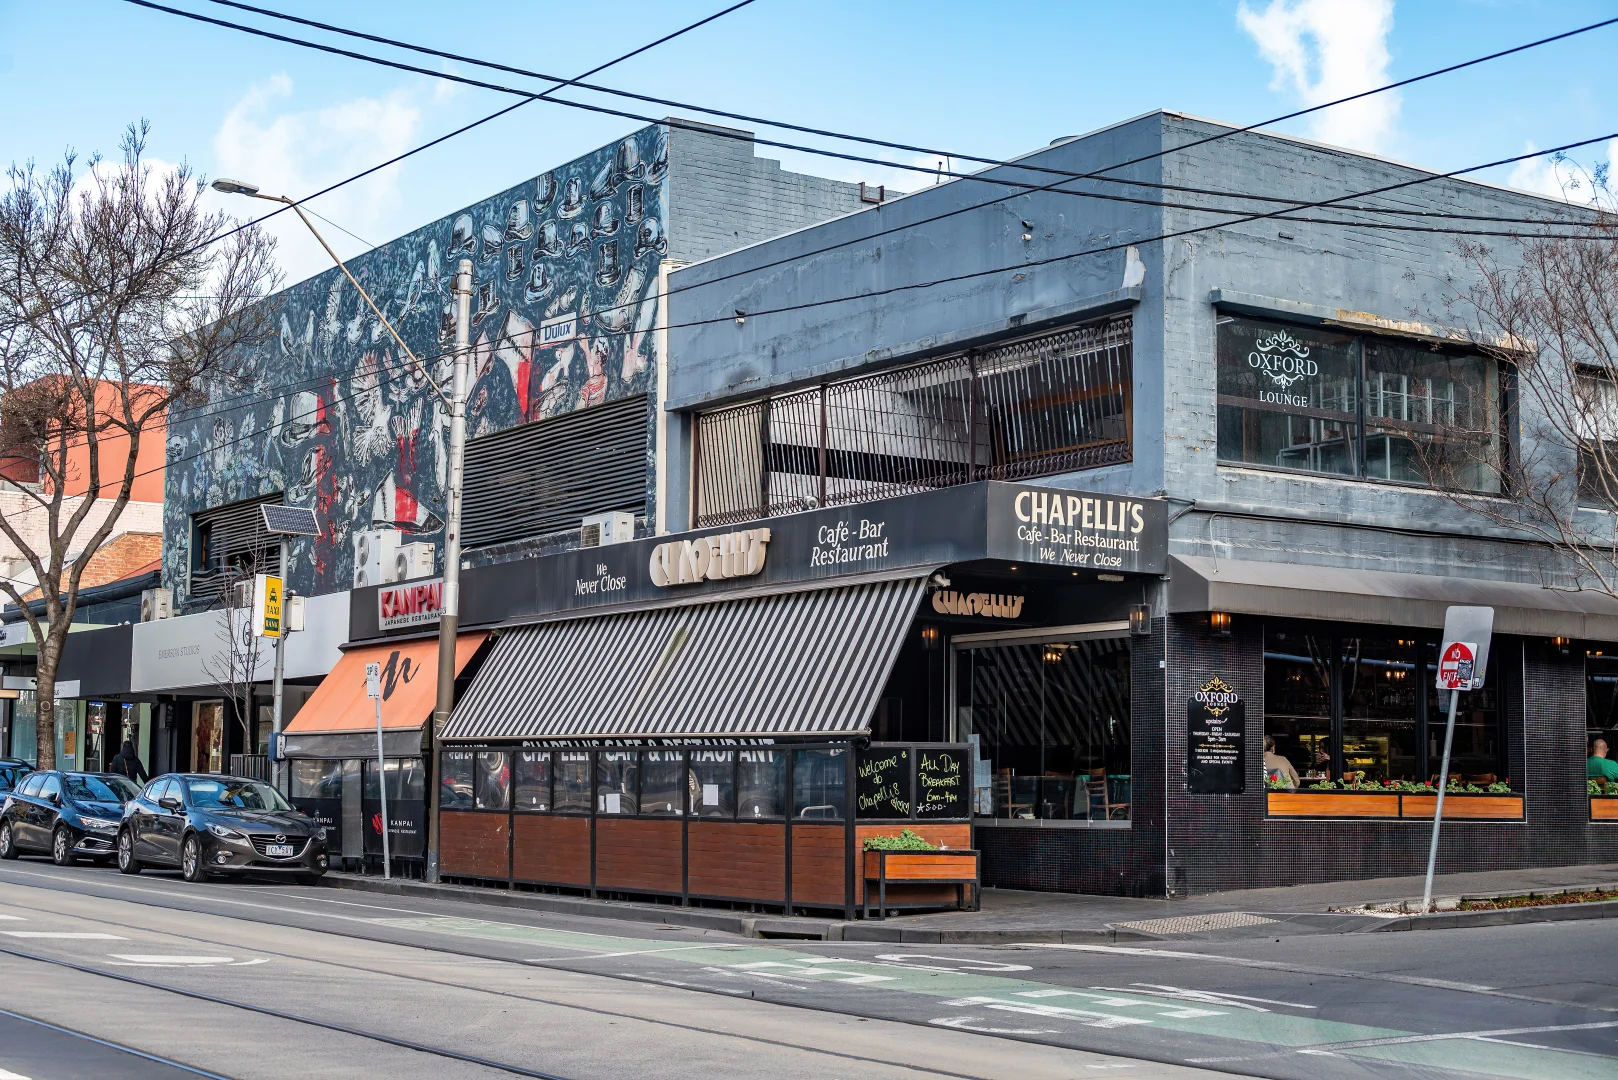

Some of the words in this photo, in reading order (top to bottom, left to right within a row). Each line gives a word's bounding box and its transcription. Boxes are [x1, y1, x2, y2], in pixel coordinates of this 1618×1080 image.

[544, 322, 572, 341] Dulux
[1248, 351, 1318, 376] OXFORD
[1259, 390, 1308, 407] LOUNGE
[1014, 491, 1145, 533] CHAPELLI'S
[818, 521, 848, 547] Café
[859, 519, 885, 539] Bar
[1017, 525, 1042, 544] Cafe
[1050, 528, 1072, 545] Bar
[1074, 529, 1140, 552] Restaurant
[810, 536, 889, 567] Restaurant
[1040, 547, 1056, 561] We
[1060, 548, 1091, 564] Never
[1093, 553, 1122, 567] Close
[596, 562, 608, 576] We
[575, 578, 599, 596] Never
[600, 573, 626, 592] Close
[267, 604, 280, 615] TAXI
[381, 582, 443, 618] KANPAI
[384, 615, 410, 626] JAPANESE
[1452, 648, 1460, 659] NO
[1443, 672, 1459, 682] ENTR
[1195, 691, 1238, 703] OXFORD
[858, 755, 898, 778] Welcome
[390, 819, 413, 827] KANPAI
